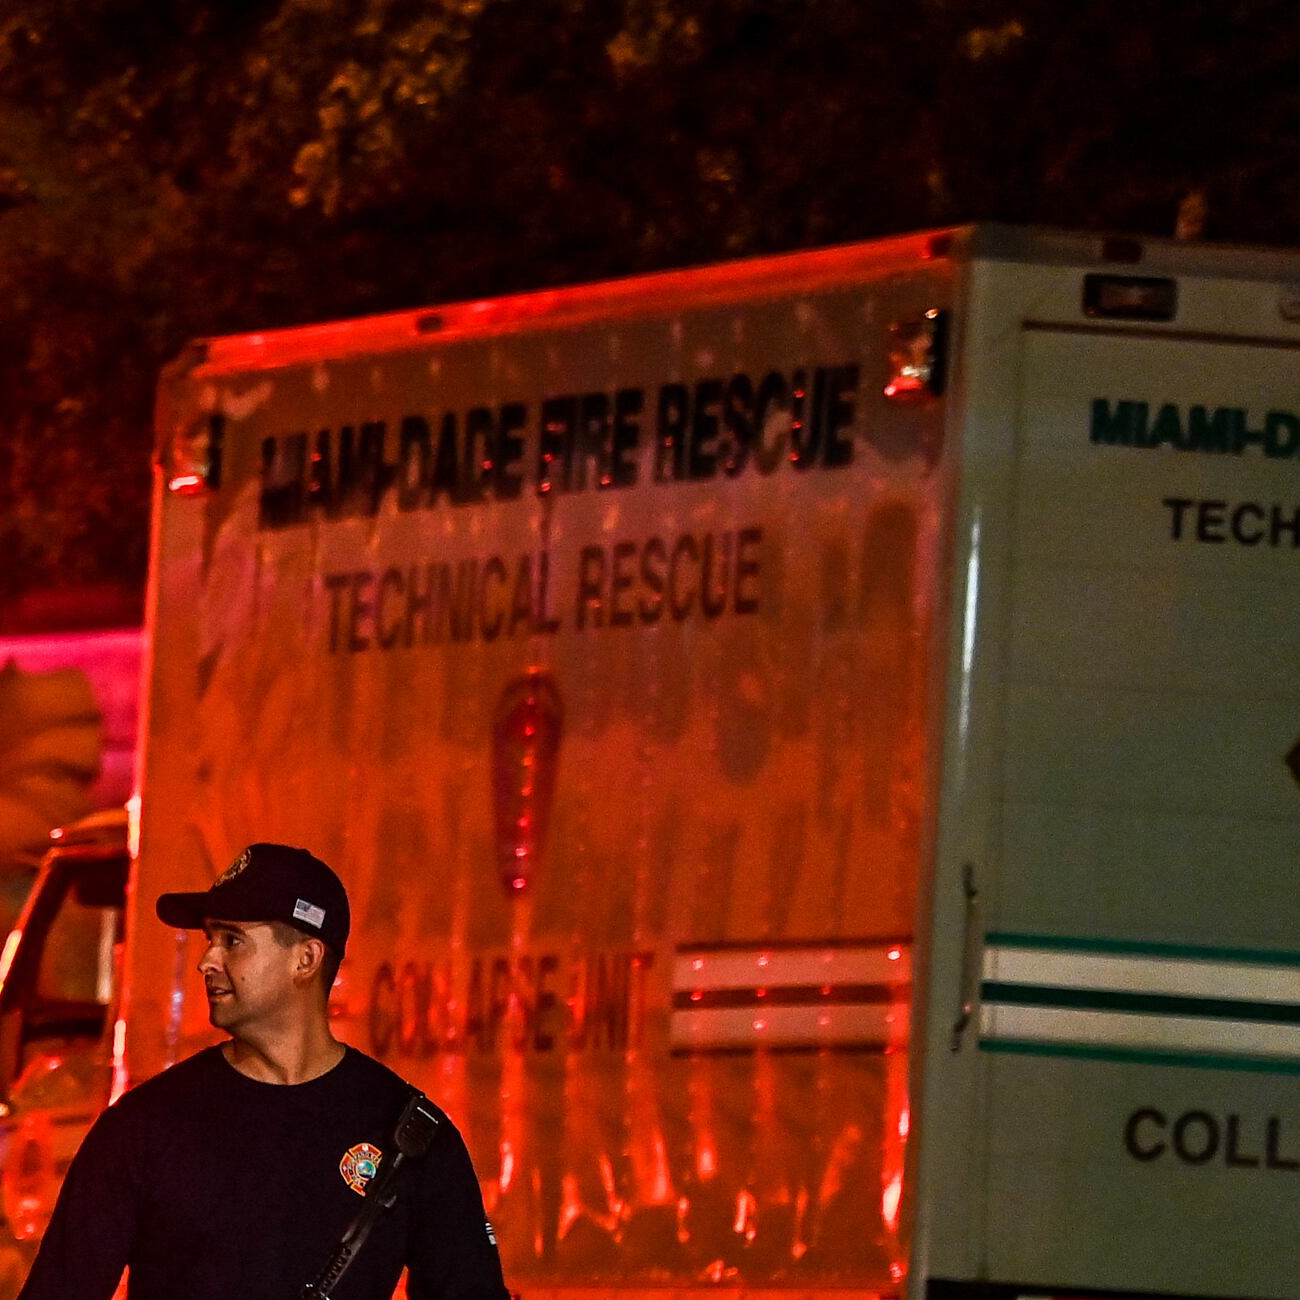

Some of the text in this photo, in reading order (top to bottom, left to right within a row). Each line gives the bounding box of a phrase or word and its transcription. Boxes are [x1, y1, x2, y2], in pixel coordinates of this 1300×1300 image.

[259, 363, 862, 531] MIAMI-DADE FIRE RESCUE
[1089, 397, 1300, 459] MIAMI-D
[1161, 498, 1300, 547] TECH
[322, 527, 762, 655] TECHNICAL RESCUE
[368, 950, 656, 1059] COLLAPSE UNIT
[1125, 1107, 1300, 1172] COLL
